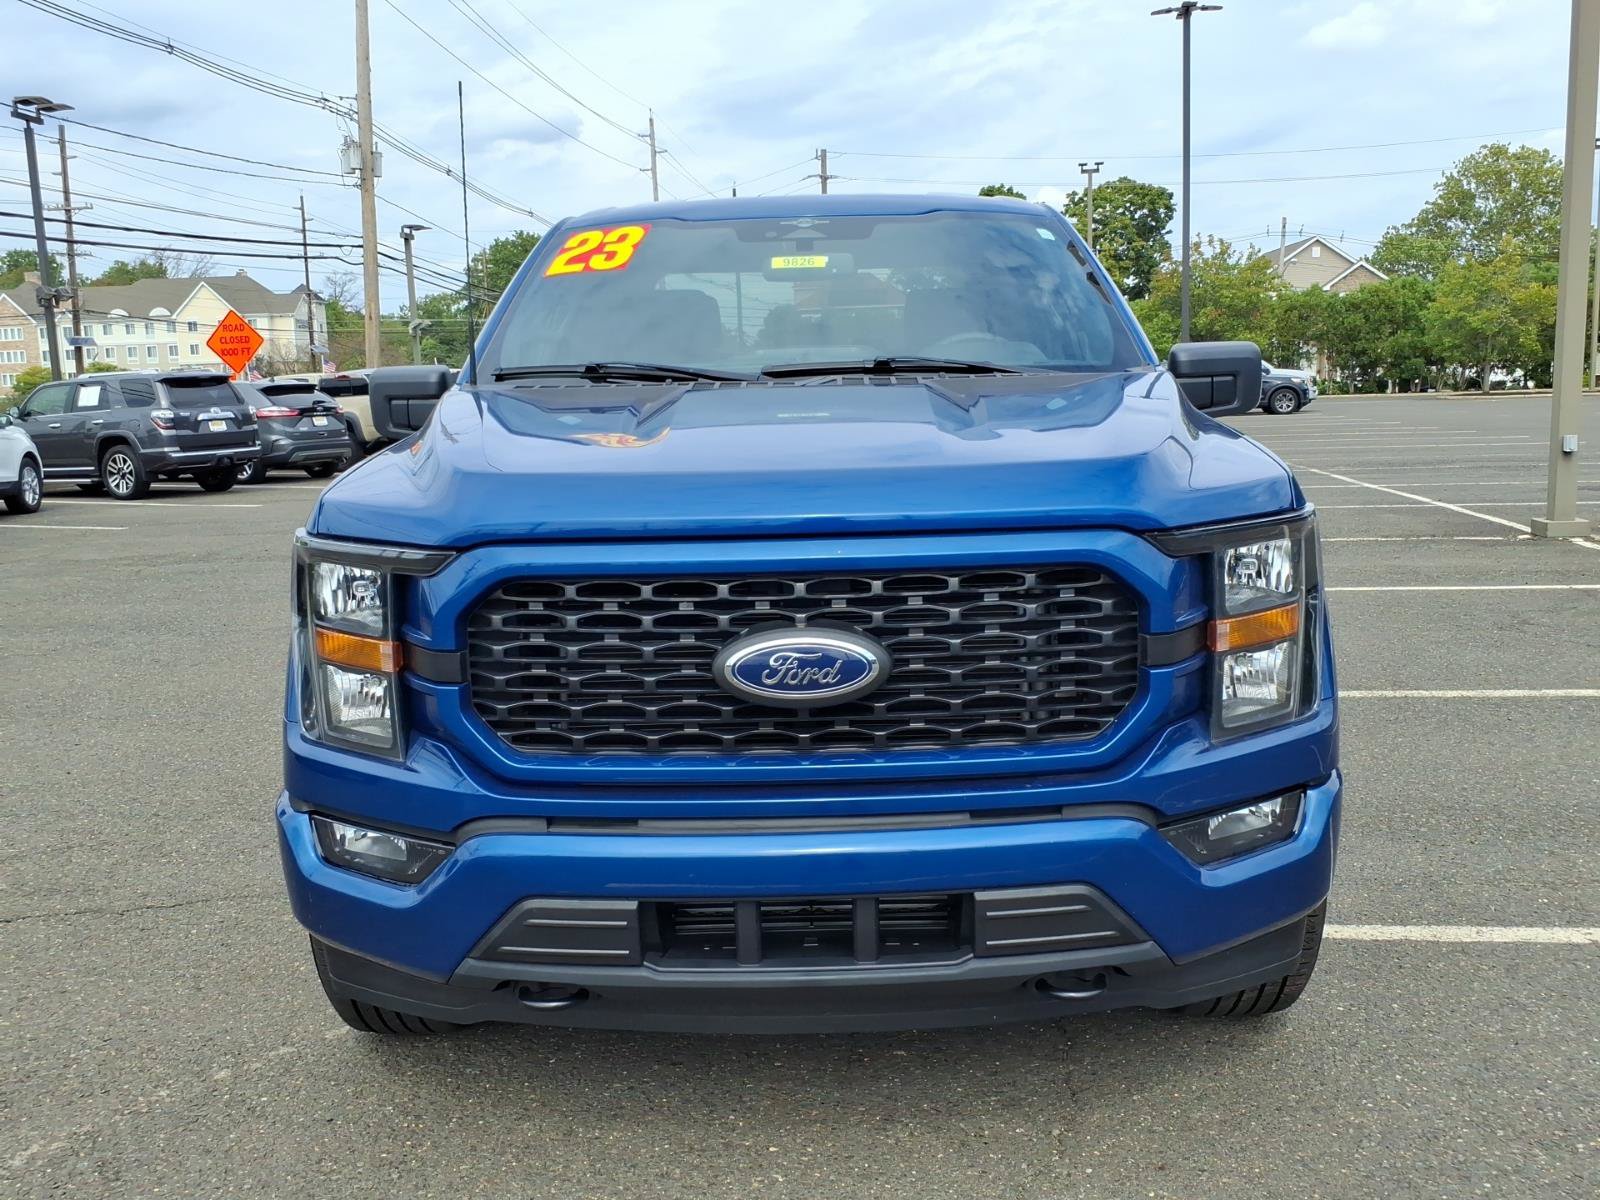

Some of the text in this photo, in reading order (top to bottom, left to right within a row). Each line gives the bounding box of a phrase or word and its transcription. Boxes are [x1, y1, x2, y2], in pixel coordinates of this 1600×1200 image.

[545, 225, 646, 277] 23
[783, 257, 815, 267] 9826
[222, 323, 245, 332] ROAD
[219, 335, 250, 345] CLOSED
[221, 347, 251, 356] 1000 FT
[761, 652, 843, 685] Ford
